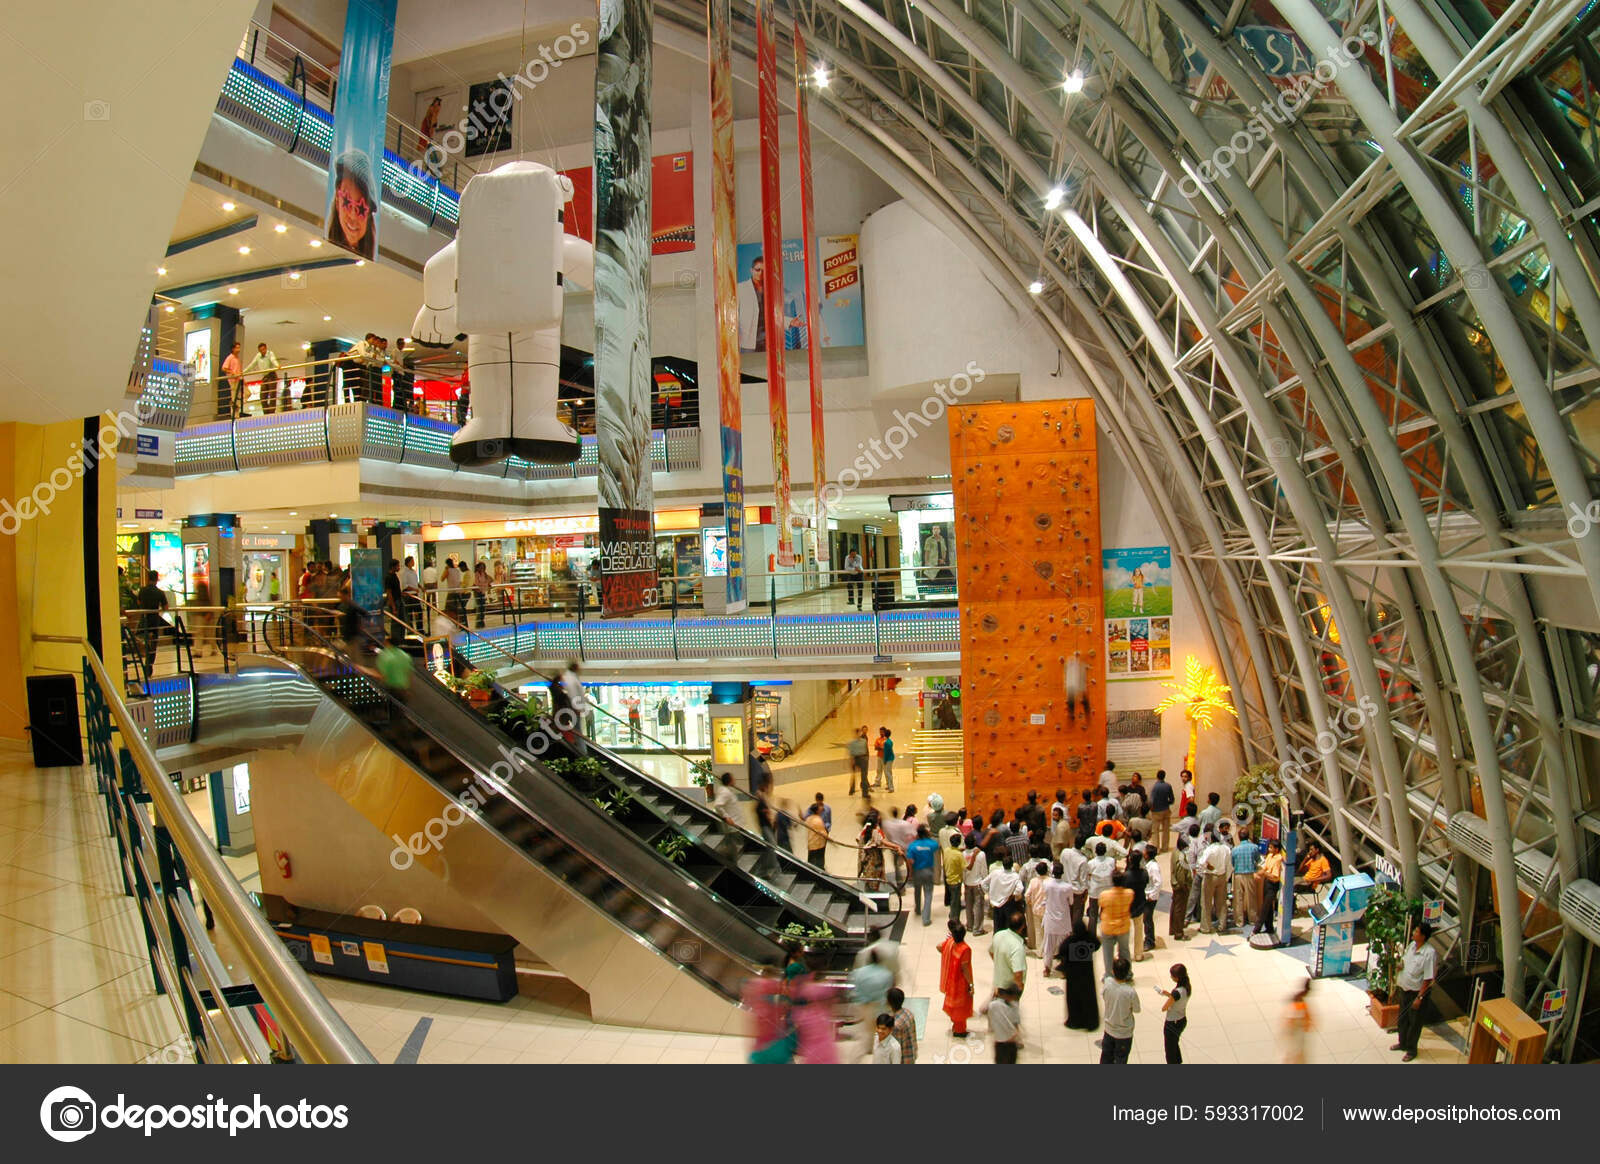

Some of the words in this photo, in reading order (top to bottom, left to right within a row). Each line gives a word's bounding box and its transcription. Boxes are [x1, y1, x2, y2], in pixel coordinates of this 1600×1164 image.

[825, 251, 855, 269] ROYAL
[828, 273, 854, 291] STAG
[1375, 853, 1402, 887] IMAX
